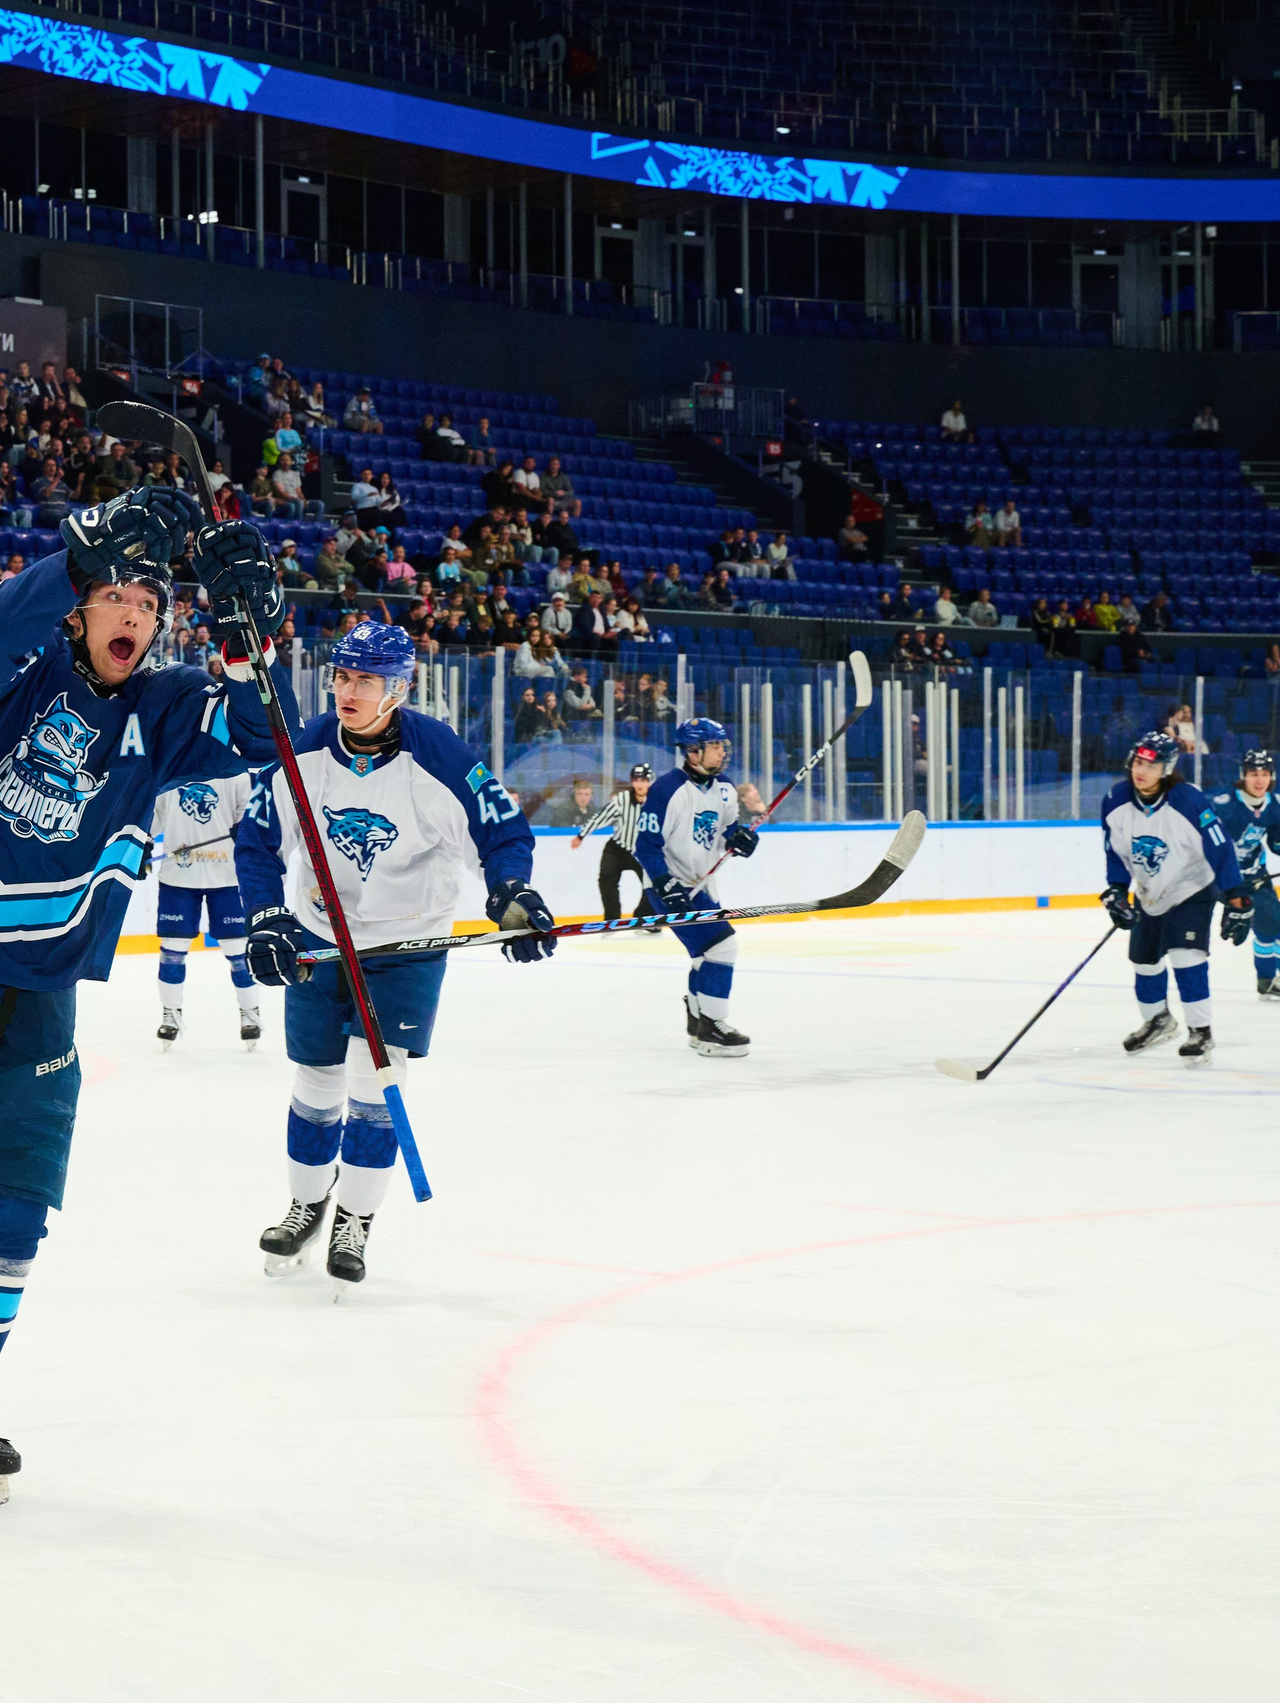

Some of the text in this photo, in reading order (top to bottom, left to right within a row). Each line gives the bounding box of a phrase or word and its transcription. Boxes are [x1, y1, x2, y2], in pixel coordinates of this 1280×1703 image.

[120, 712, 146, 757] A
[795, 742, 831, 782] CCM
[477, 783, 521, 825] 43
[1207, 824, 1226, 846] 11
[251, 906, 297, 927] BAU
[579, 910, 721, 933] SOYUZ
[397, 940, 427, 951] ACE
[429, 935, 469, 948] prime
